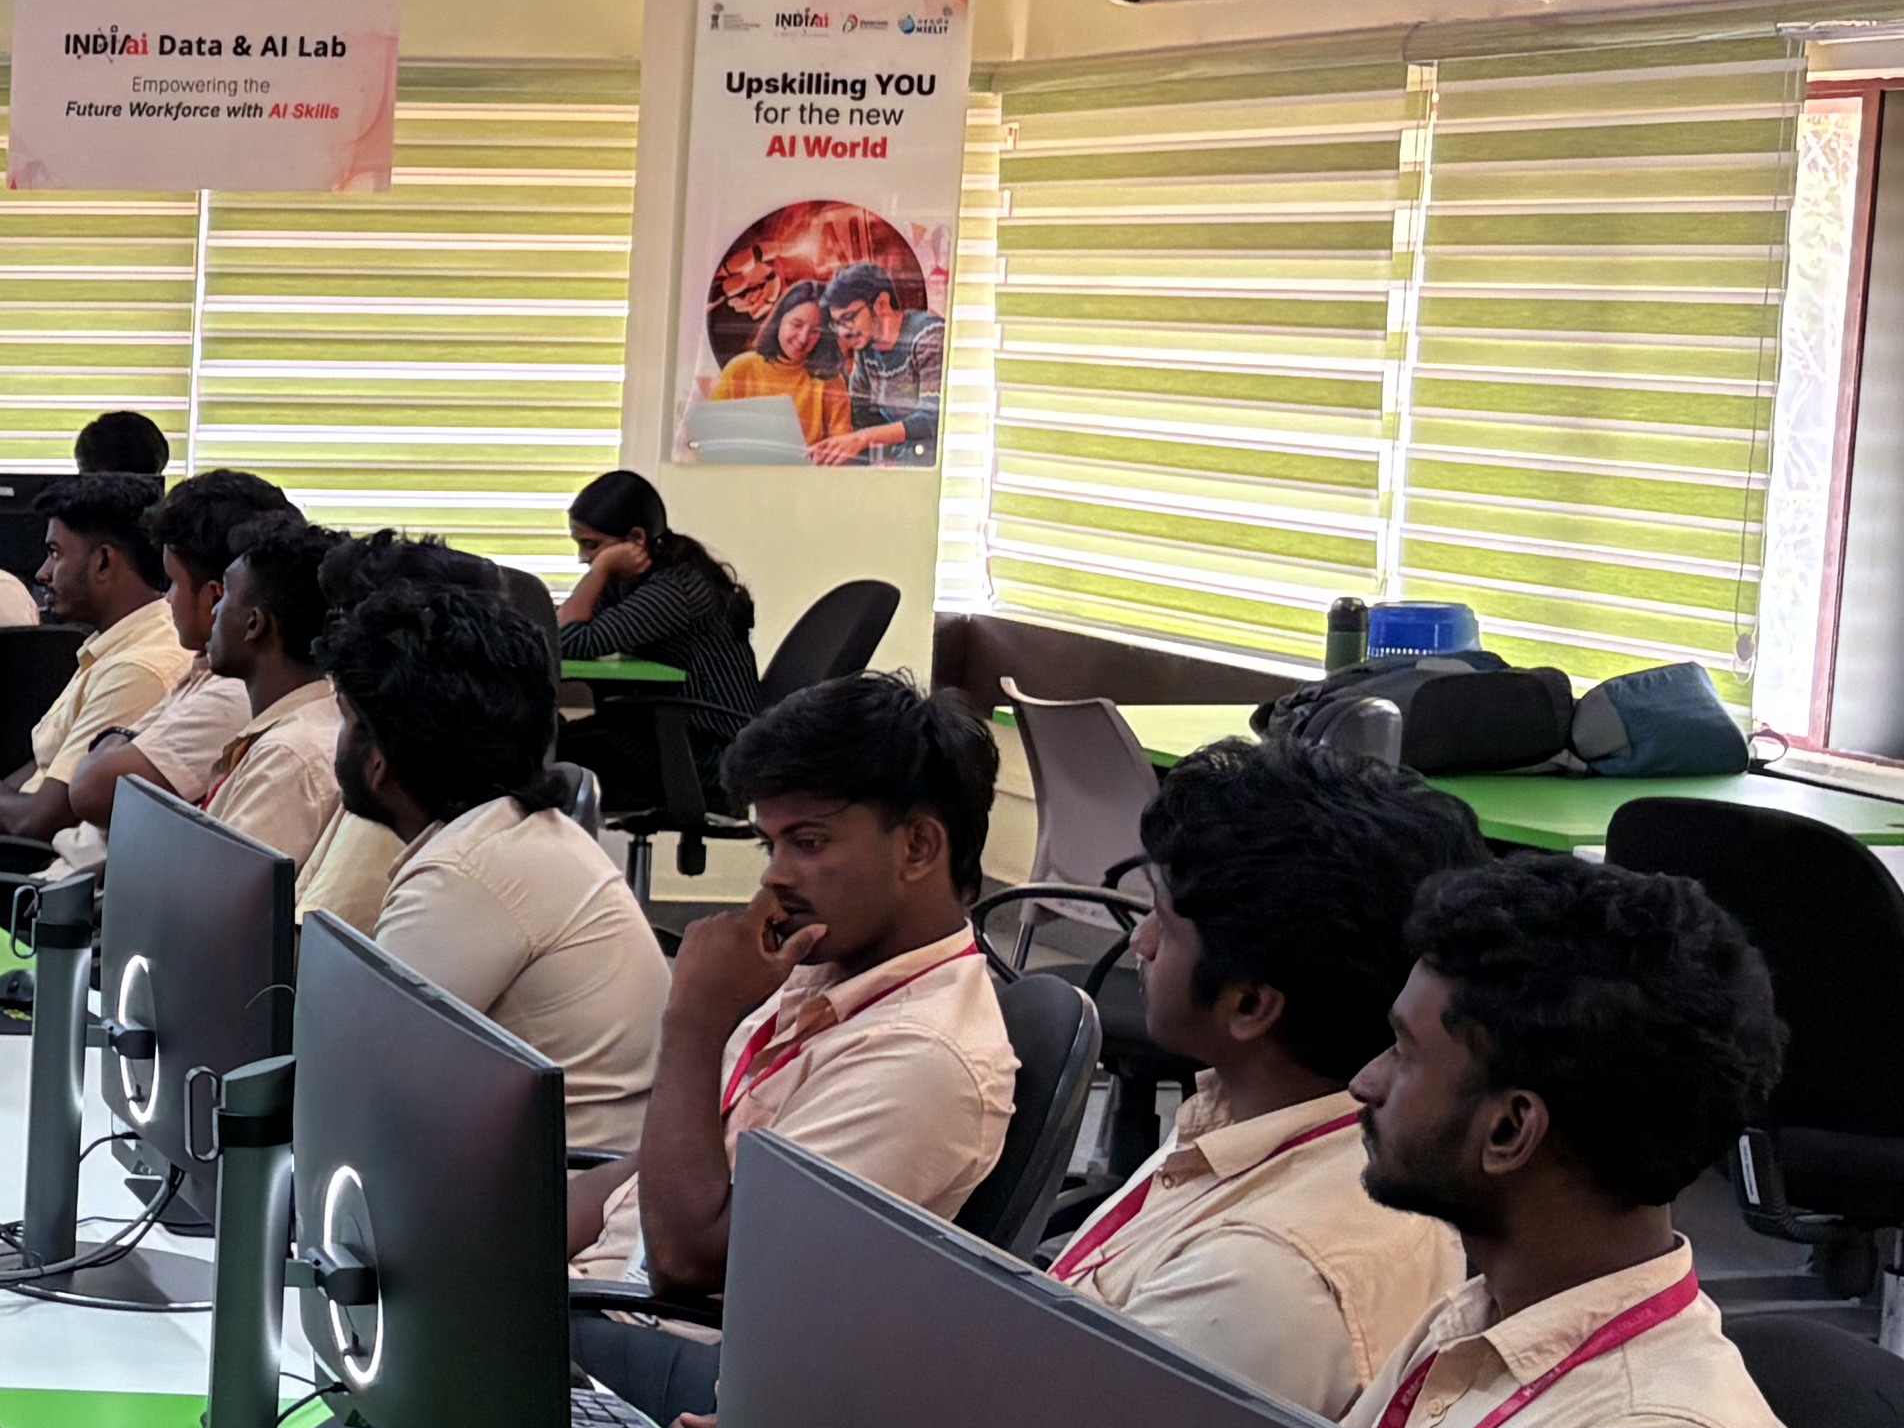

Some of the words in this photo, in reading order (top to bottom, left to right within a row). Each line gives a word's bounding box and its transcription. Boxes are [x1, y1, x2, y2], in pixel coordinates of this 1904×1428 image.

[158, 35, 223, 57] Data
[232, 35, 251, 57] &
[260, 35, 288, 57] AI
[298, 35, 347, 58] Lab
[132, 76, 238, 97] Empowering
[243, 77, 271, 94] the
[726, 71, 867, 101] Upskilling
[874, 74, 936, 96] YOU
[66, 101, 122, 118] Future
[129, 102, 220, 121] Workforce
[226, 103, 264, 119] with
[268, 103, 288, 119] AI
[291, 103, 340, 120] Skills
[754, 101, 790, 124] for
[799, 102, 840, 125] the
[849, 108, 904, 126] new
[766, 135, 796, 158] AI
[803, 135, 888, 159] World
